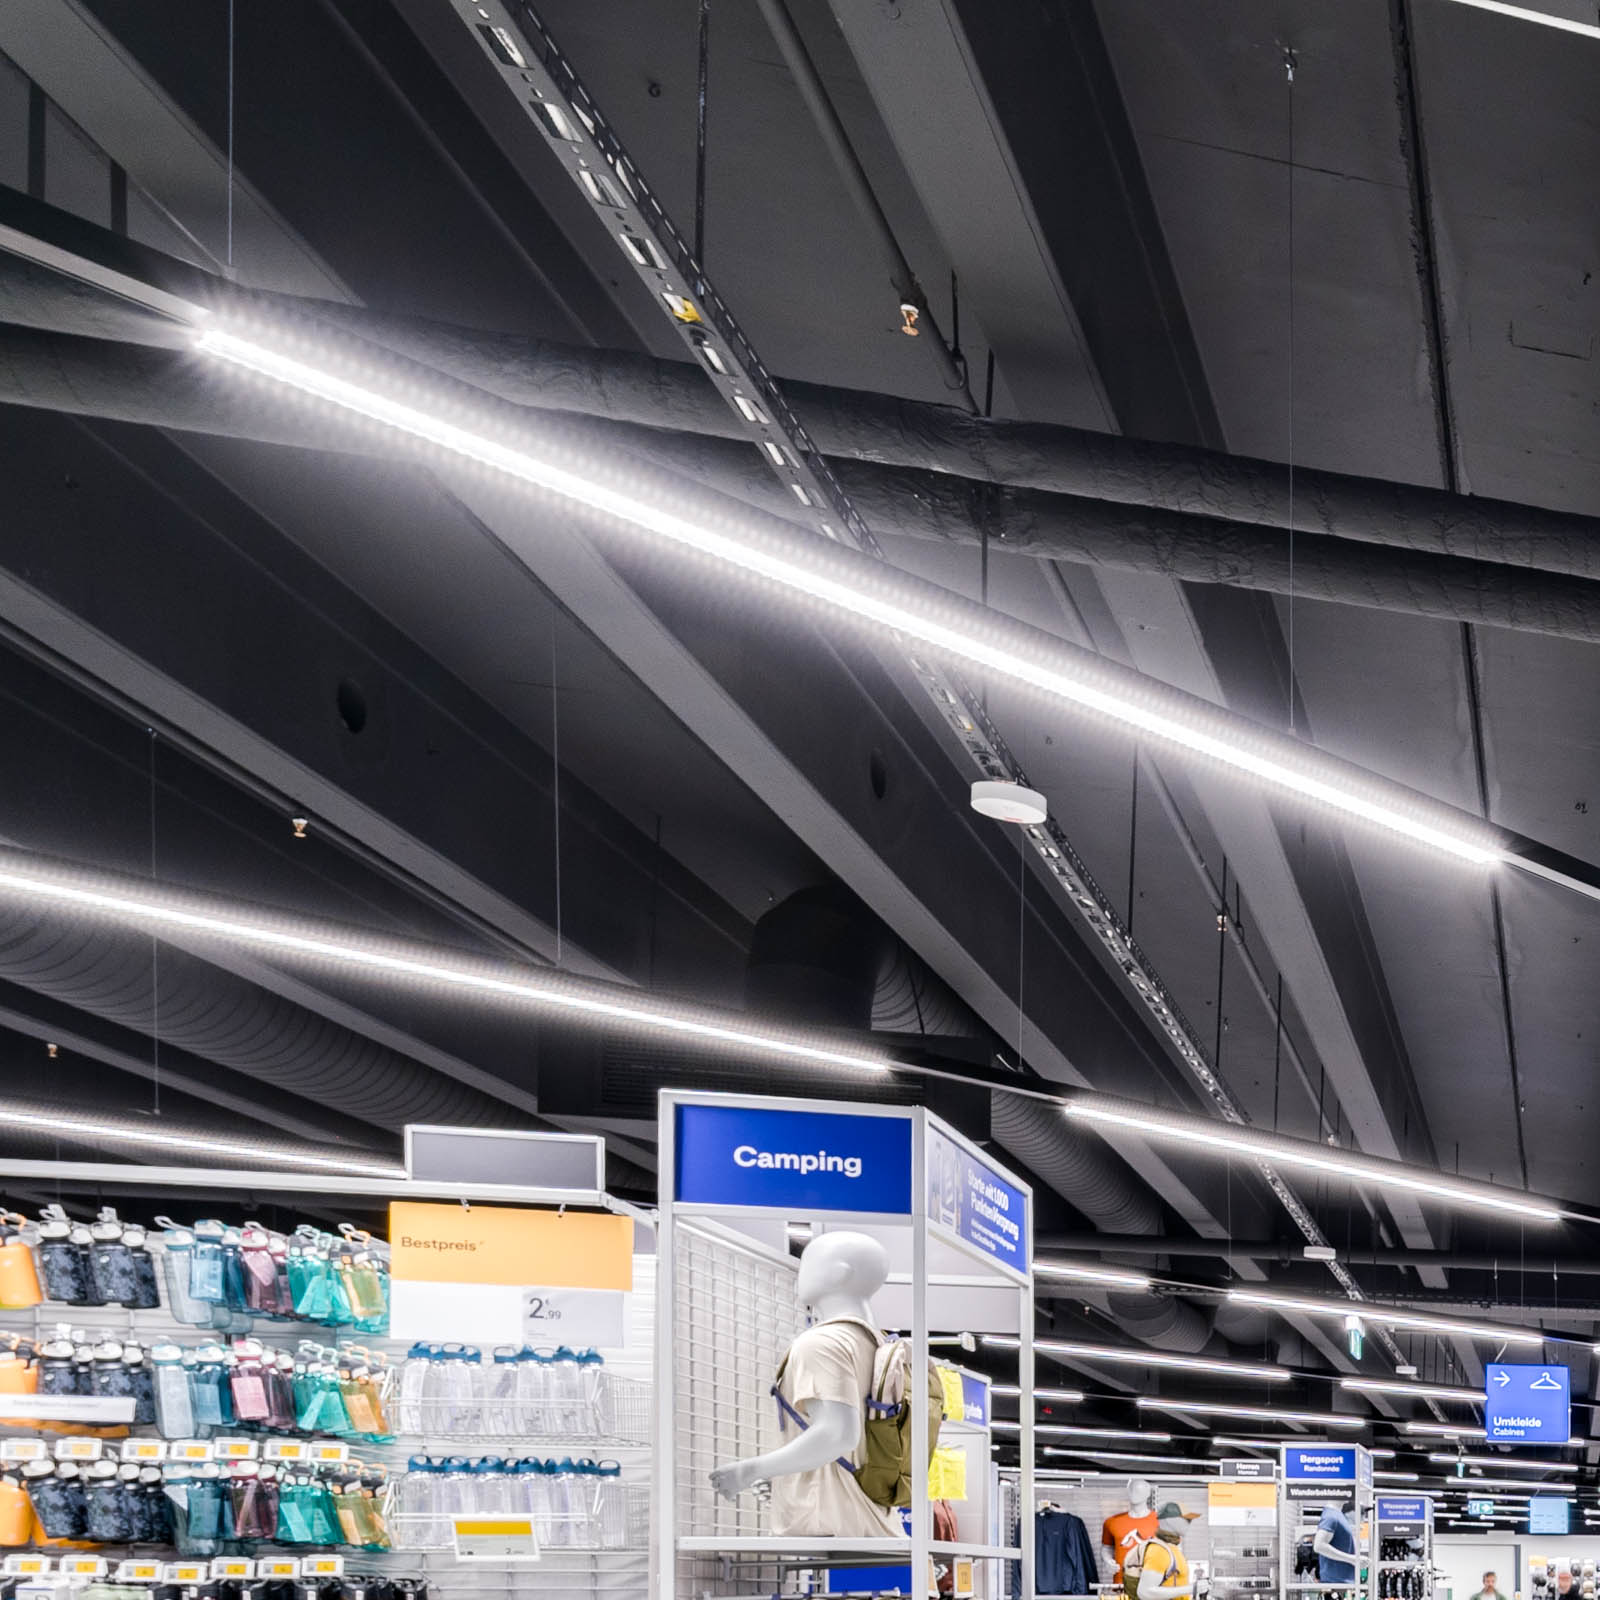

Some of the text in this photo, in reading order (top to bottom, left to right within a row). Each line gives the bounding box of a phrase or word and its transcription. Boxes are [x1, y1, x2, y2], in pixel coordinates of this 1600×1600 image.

[733, 1145, 862, 1178] Camping
[401, 1236, 477, 1251] Bestpreis
[1493, 1416, 1542, 1427] Umkleide
[1300, 1455, 1344, 1465] Bergsport
